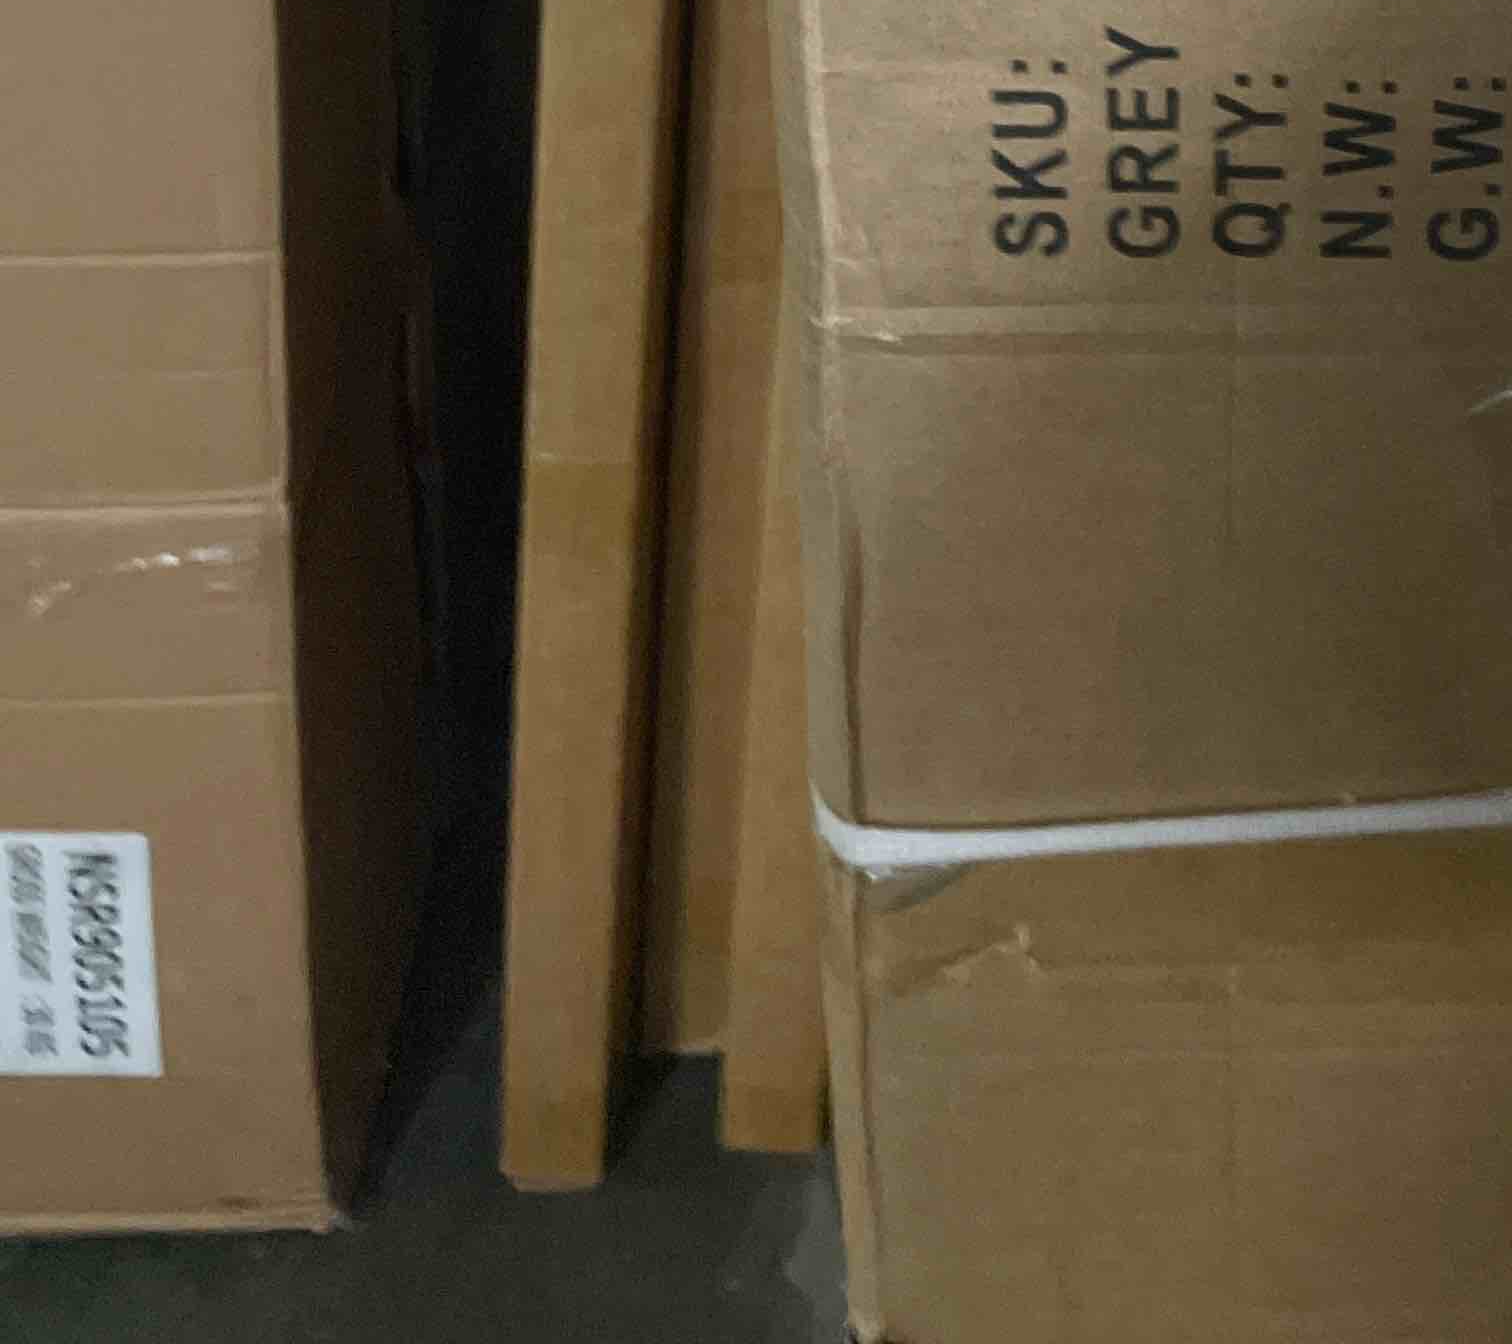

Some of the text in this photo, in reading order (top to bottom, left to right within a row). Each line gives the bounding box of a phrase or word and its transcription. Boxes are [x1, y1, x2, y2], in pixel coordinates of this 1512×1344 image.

[992, 59, 1069, 259] SKU:
[1106, 26, 1182, 259] GREY
[1212, 74, 1292, 259] QTY:
[1319, 82, 1397, 259] N.W:
[1427, 77, 1506, 261] G.W:
